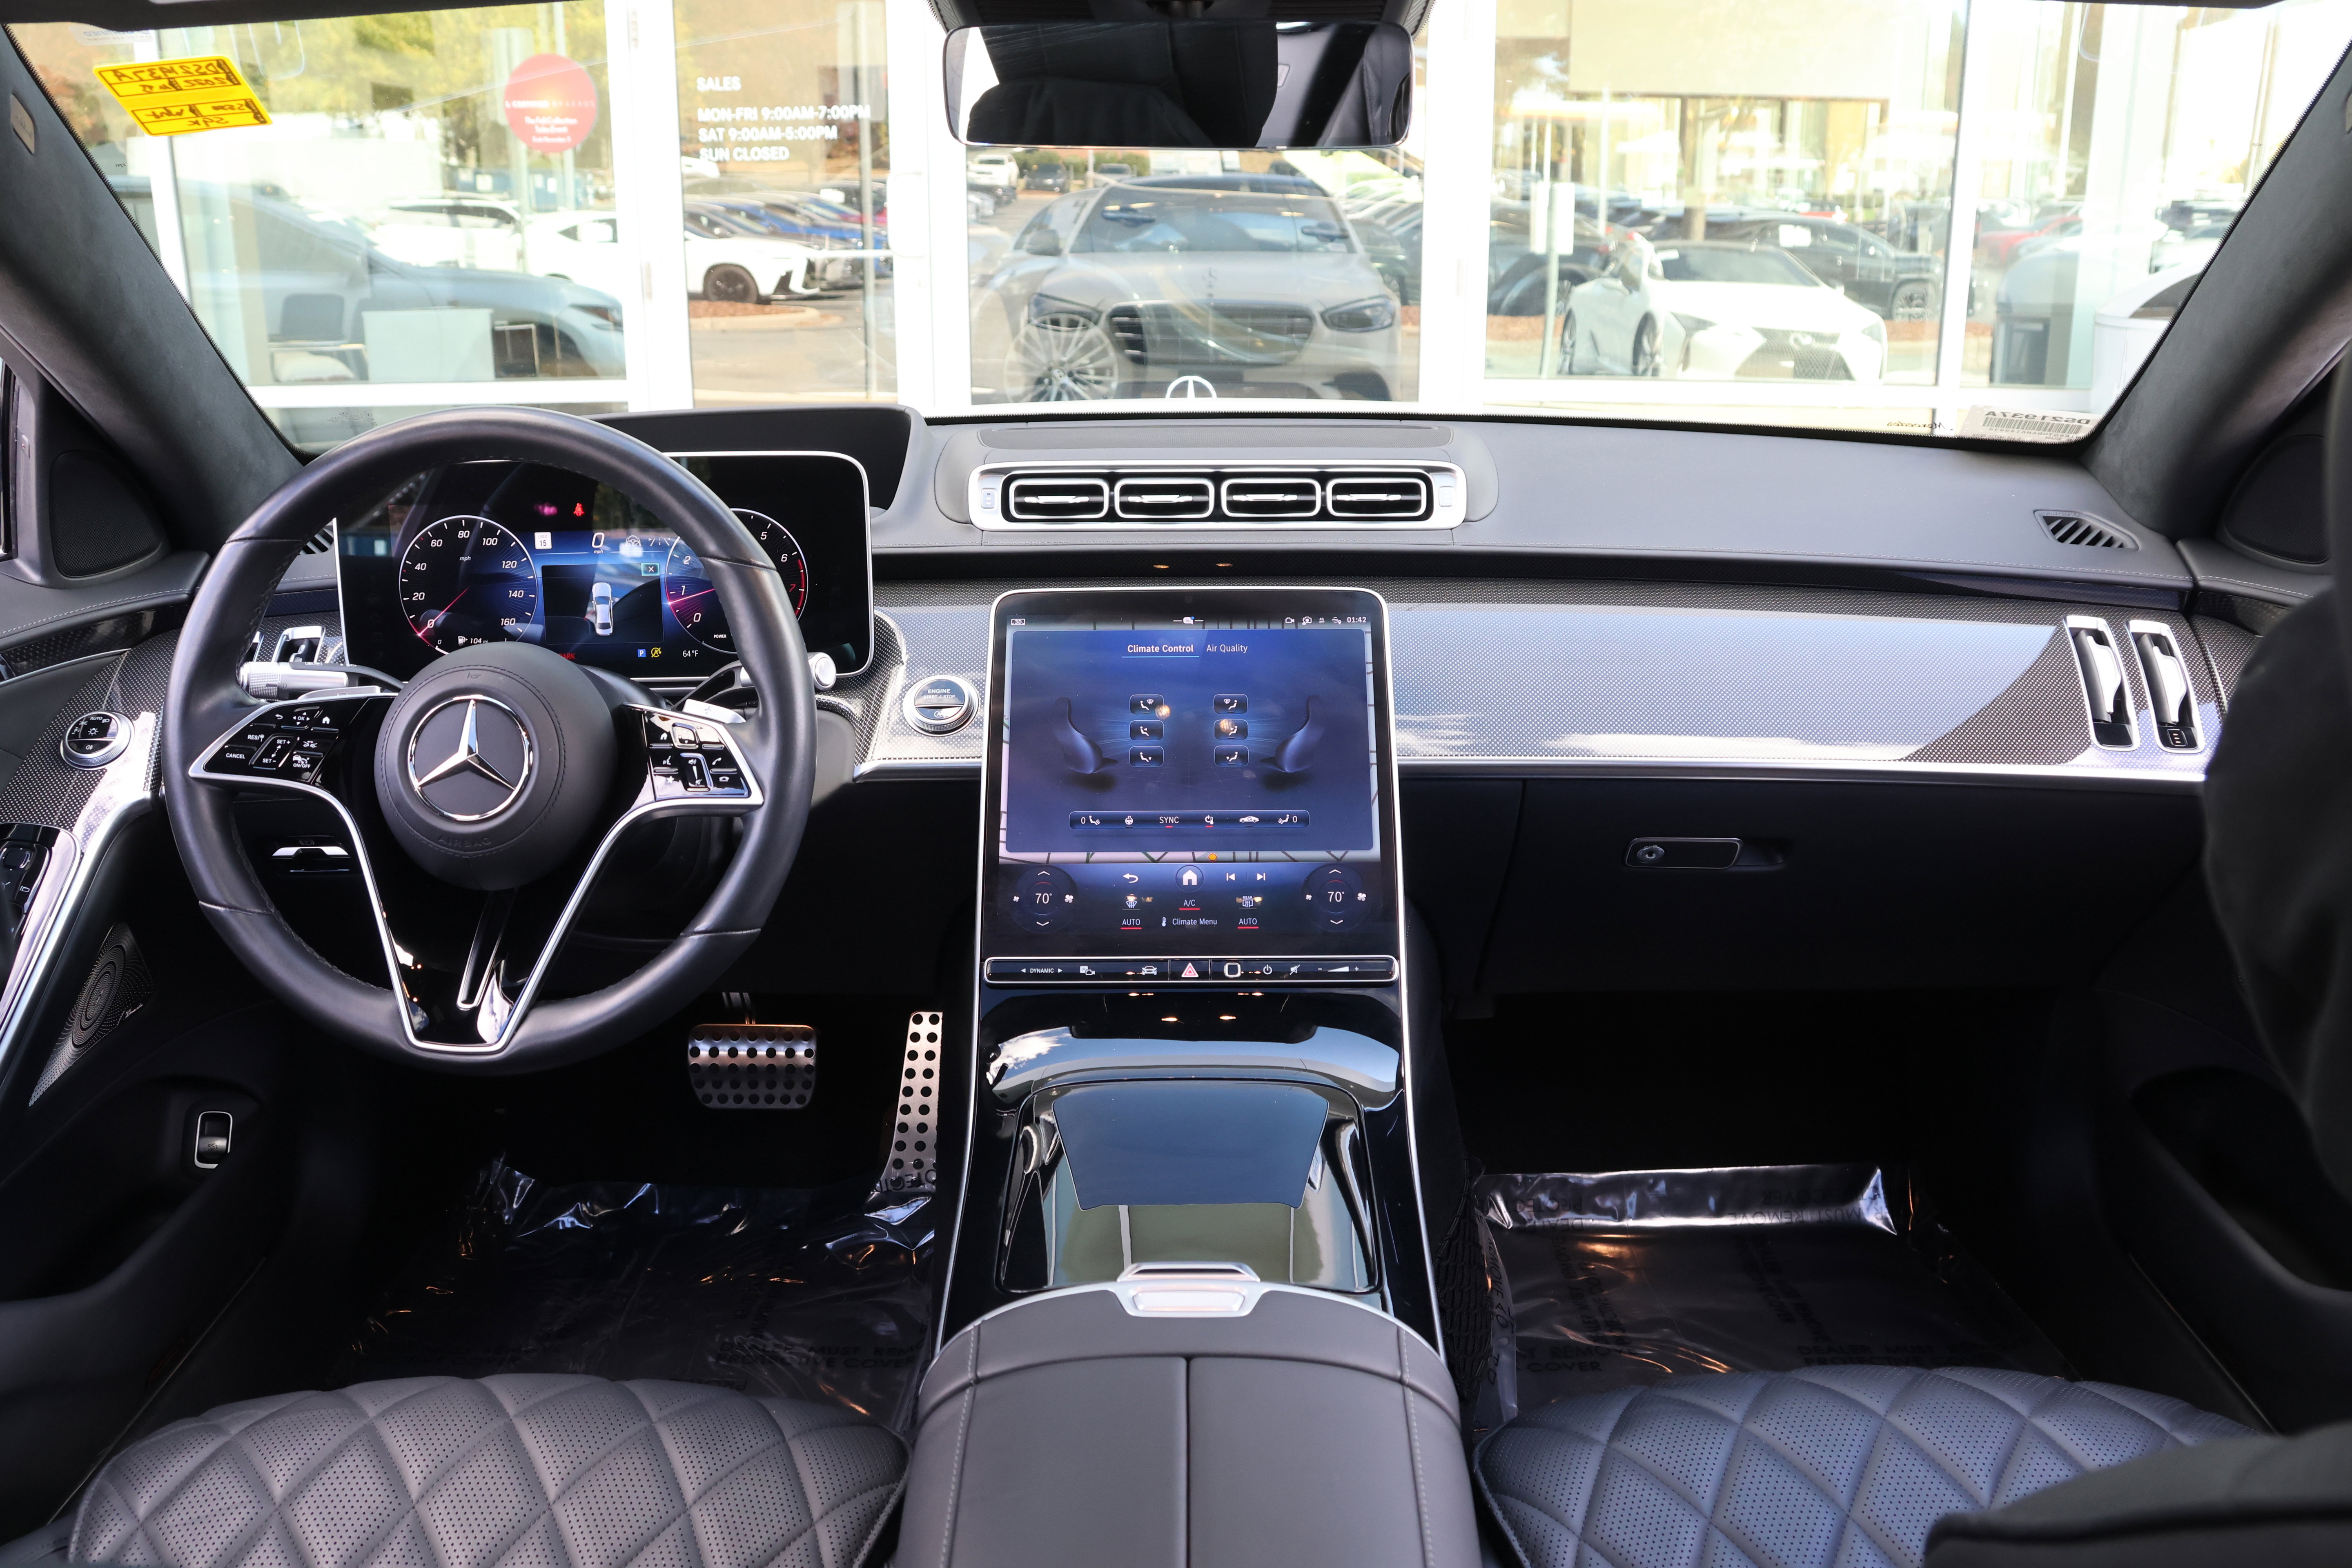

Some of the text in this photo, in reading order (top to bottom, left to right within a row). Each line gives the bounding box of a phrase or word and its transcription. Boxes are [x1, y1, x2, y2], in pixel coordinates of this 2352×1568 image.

[696, 76, 741, 91] SALES
[697, 105, 871, 122] MON-FRI 9:00AM-7:00PM
[698, 125, 837, 142] SAT 9:00AM-5:00PM
[699, 146, 790, 161] SUN CLOSED
[592, 532, 605, 548] 0
[760, 532, 767, 540] 5
[431, 539, 443, 547] 60
[684, 556, 690, 564] 2
[781, 554, 788, 562] 6
[681, 585, 686, 595] 1
[693, 613, 701, 622] 0
[427, 619, 434, 628] 0
[1162, 644, 1194, 653] Control
[1220, 644, 1248, 653] Quality
[808, 1346, 860, 1355] MUST
[844, 1355, 915, 1369] COVER
[1527, 1361, 1602, 1372] COVER
